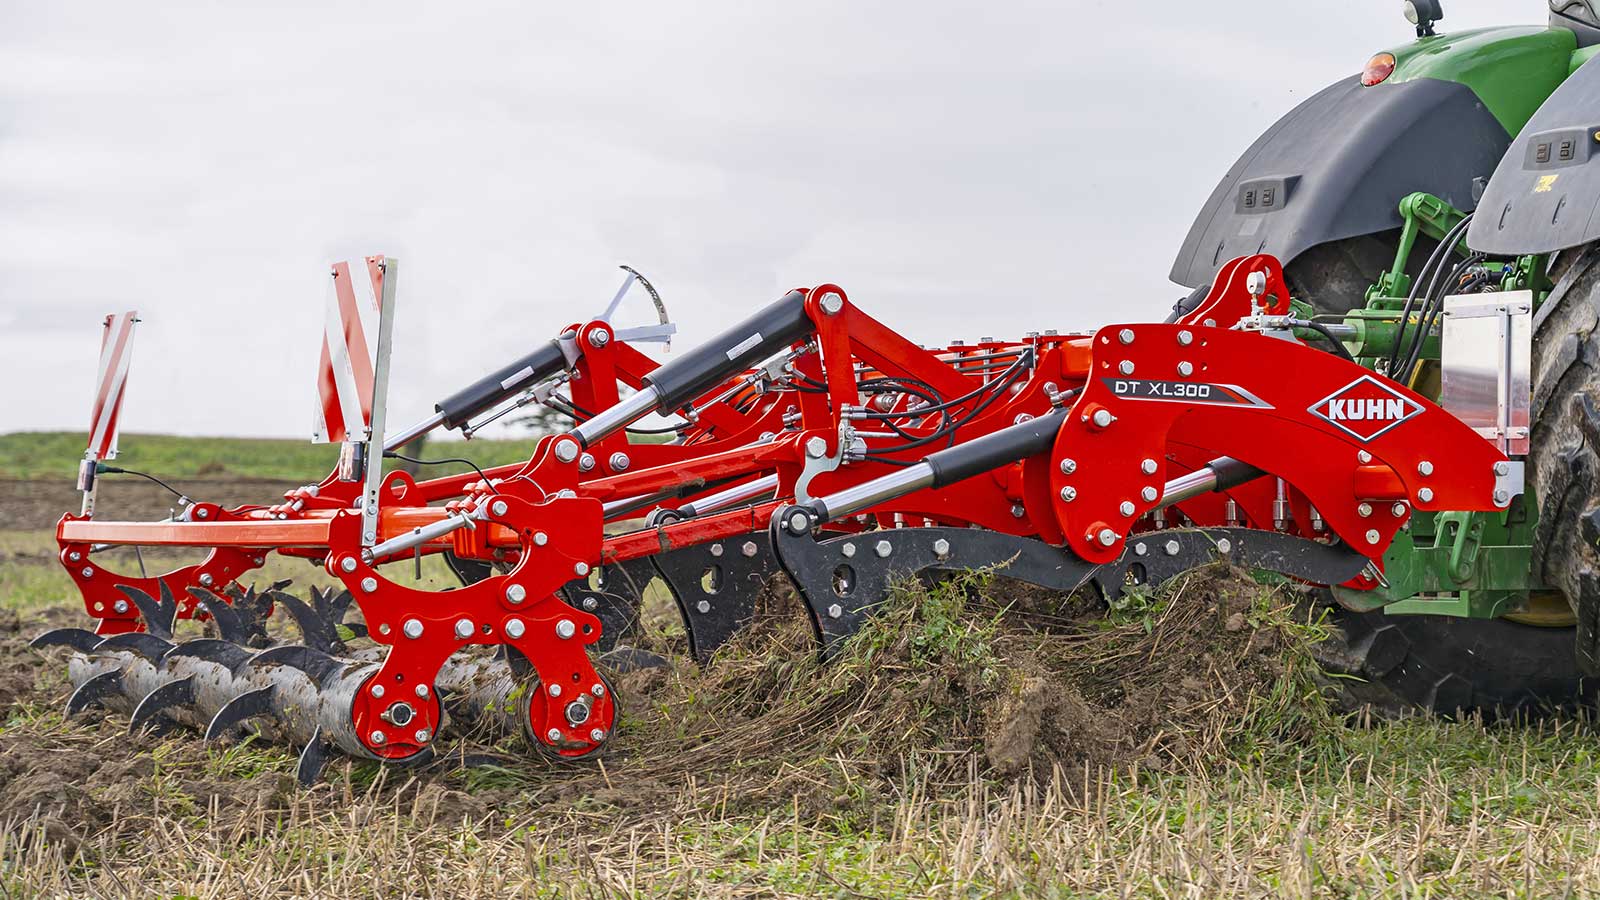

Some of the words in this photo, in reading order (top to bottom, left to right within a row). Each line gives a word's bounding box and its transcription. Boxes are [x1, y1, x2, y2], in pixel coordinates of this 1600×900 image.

[1115, 381, 1140, 394] DT
[1148, 382, 1210, 398] XL300
[1328, 398, 1404, 420] KUHN
